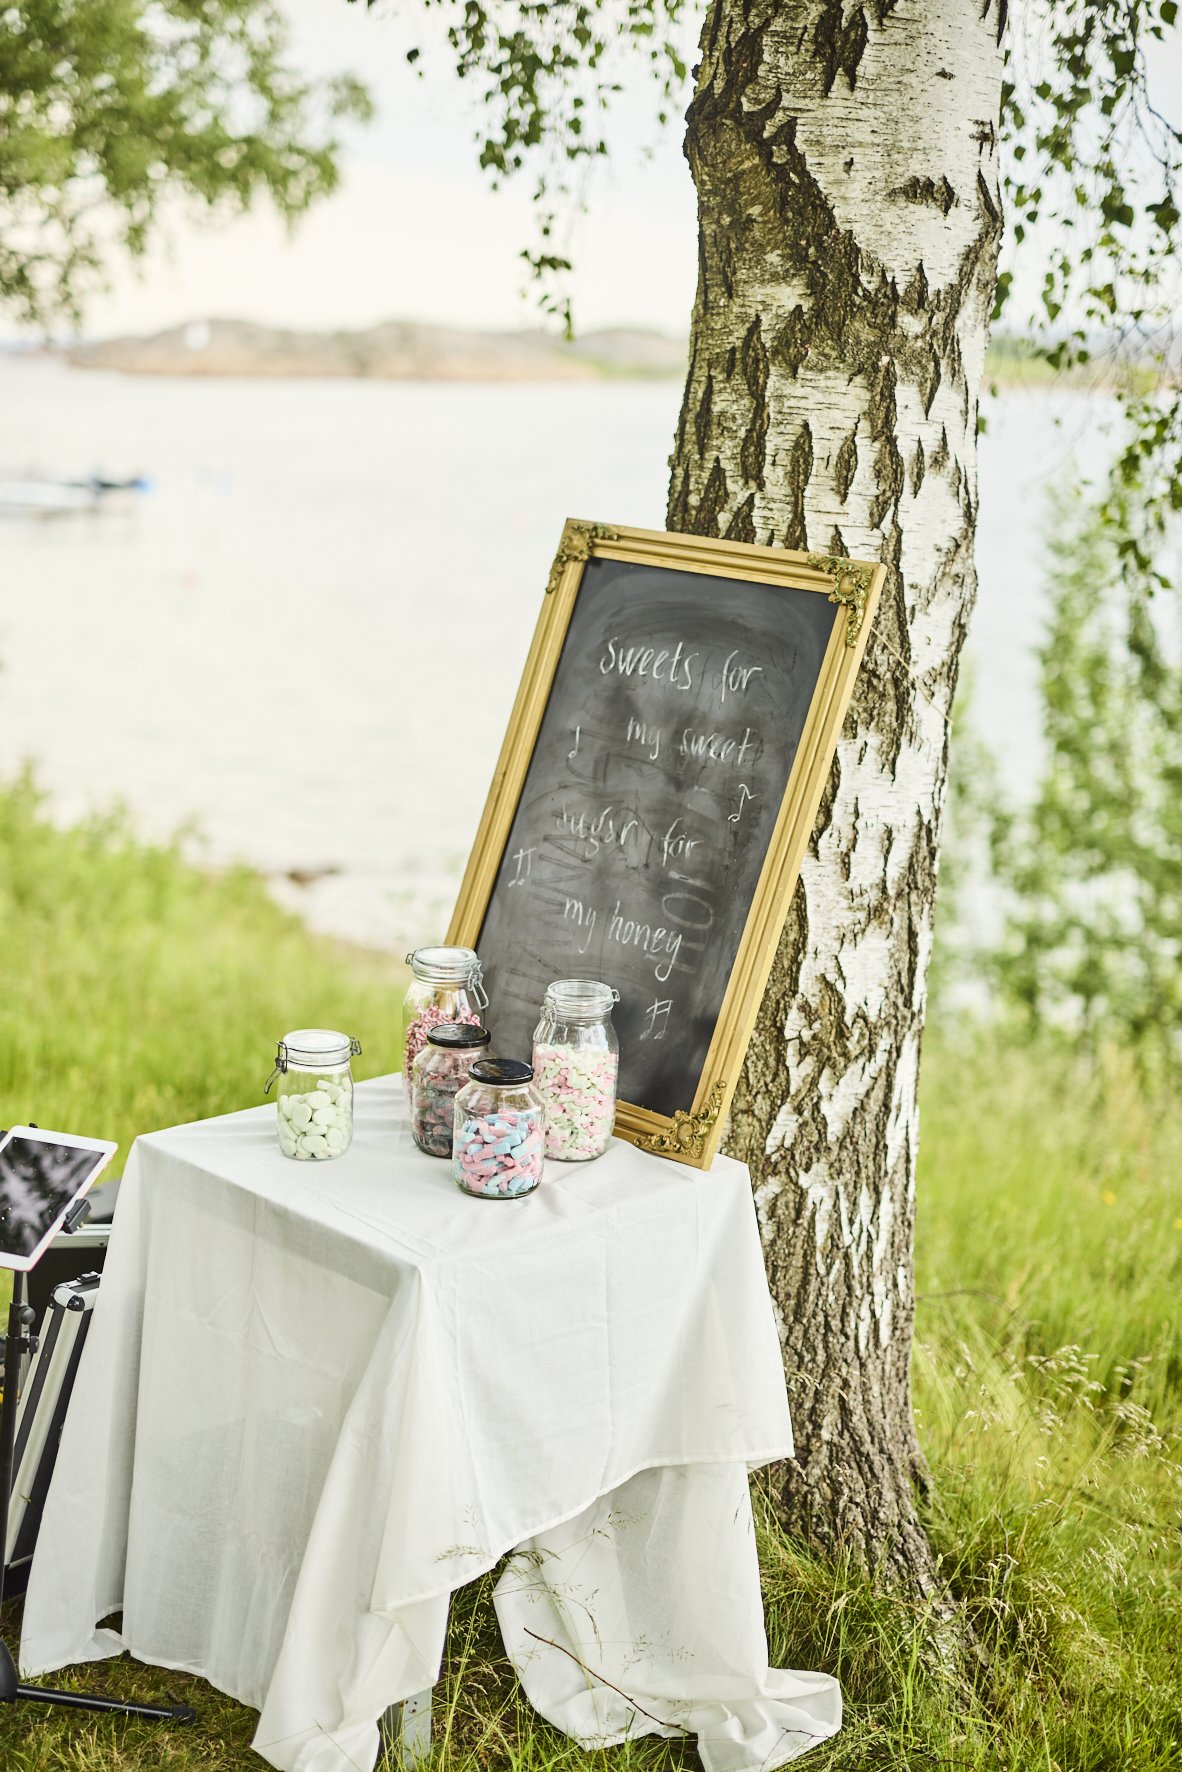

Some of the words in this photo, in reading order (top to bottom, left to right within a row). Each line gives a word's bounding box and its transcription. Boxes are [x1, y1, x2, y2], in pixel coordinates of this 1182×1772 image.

[719, 650, 763, 702] for
[626, 716, 660, 760] my
[680, 727, 753, 766] sweet
[661, 817, 704, 867] for
[564, 898, 597, 954] my
[608, 900, 684, 982] honey
